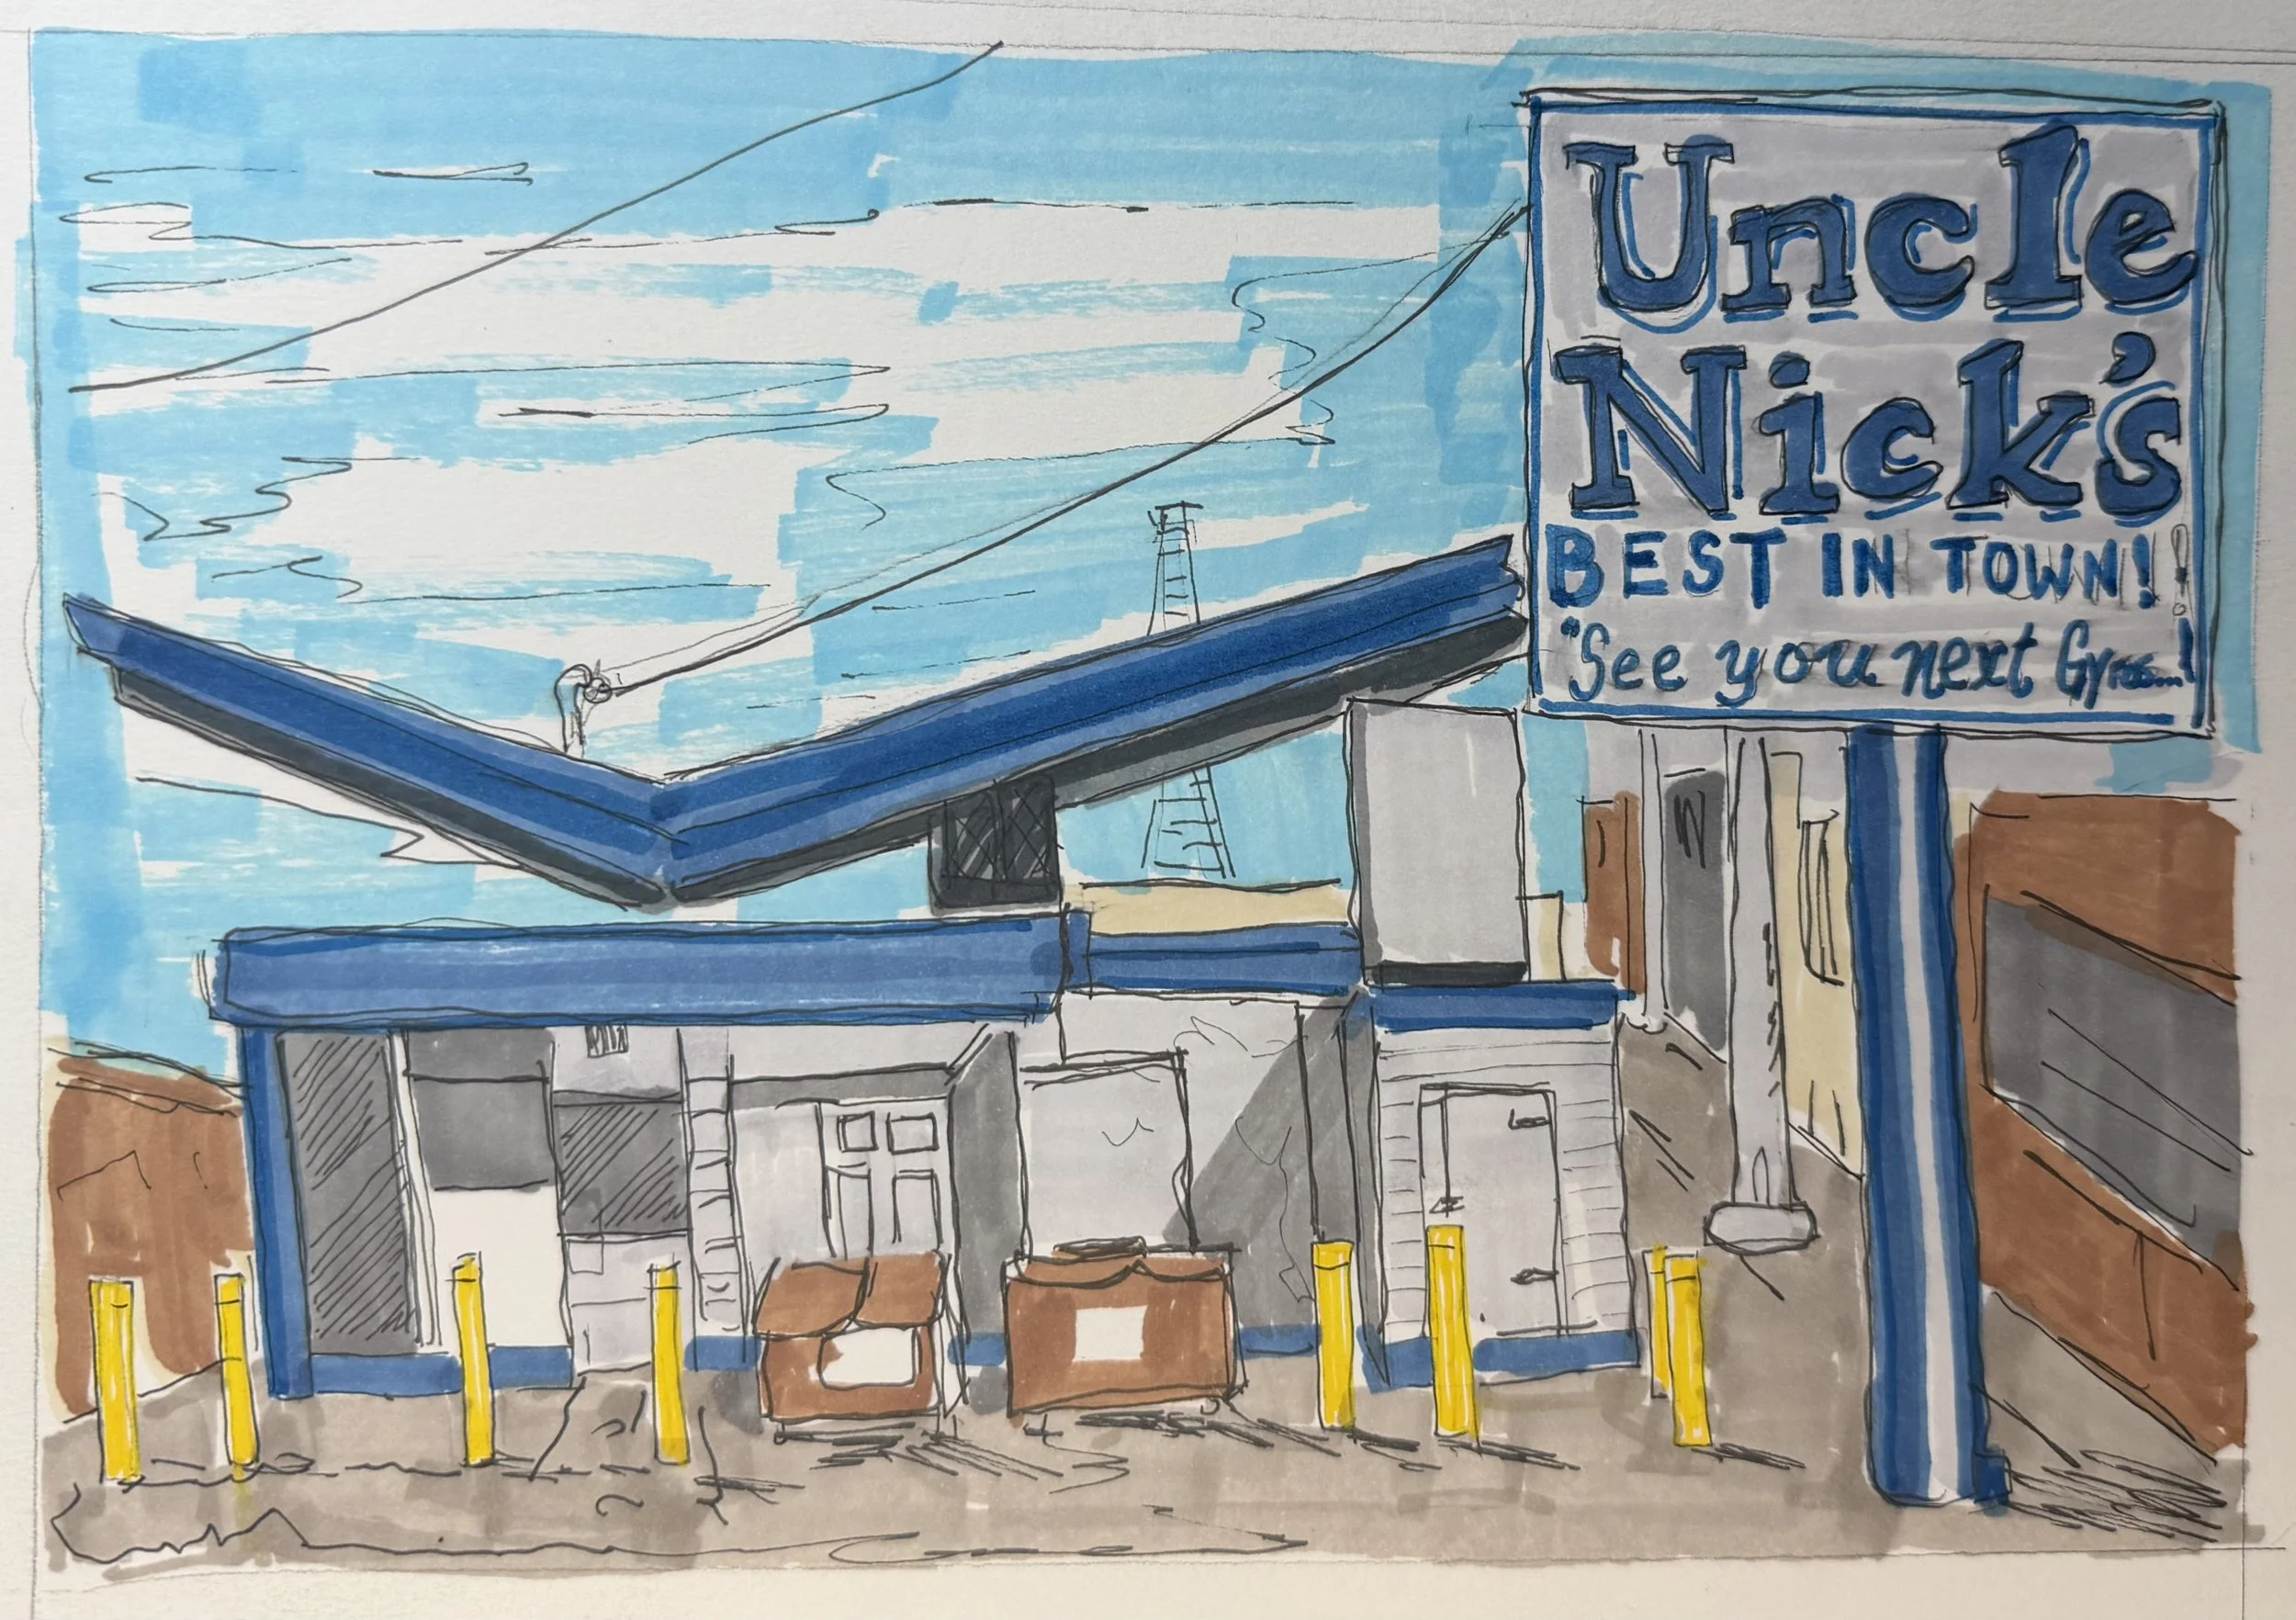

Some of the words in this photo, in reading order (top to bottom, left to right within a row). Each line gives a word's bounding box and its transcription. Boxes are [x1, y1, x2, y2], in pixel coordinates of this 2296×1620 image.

[1564, 122, 2199, 331] Uncle
[1552, 332, 2182, 520] Nick's
[1545, 523, 1786, 609] BEST
[1822, 533, 1895, 599] IN
[1715, 639, 1884, 706] you
[1891, 622, 2039, 700] next
